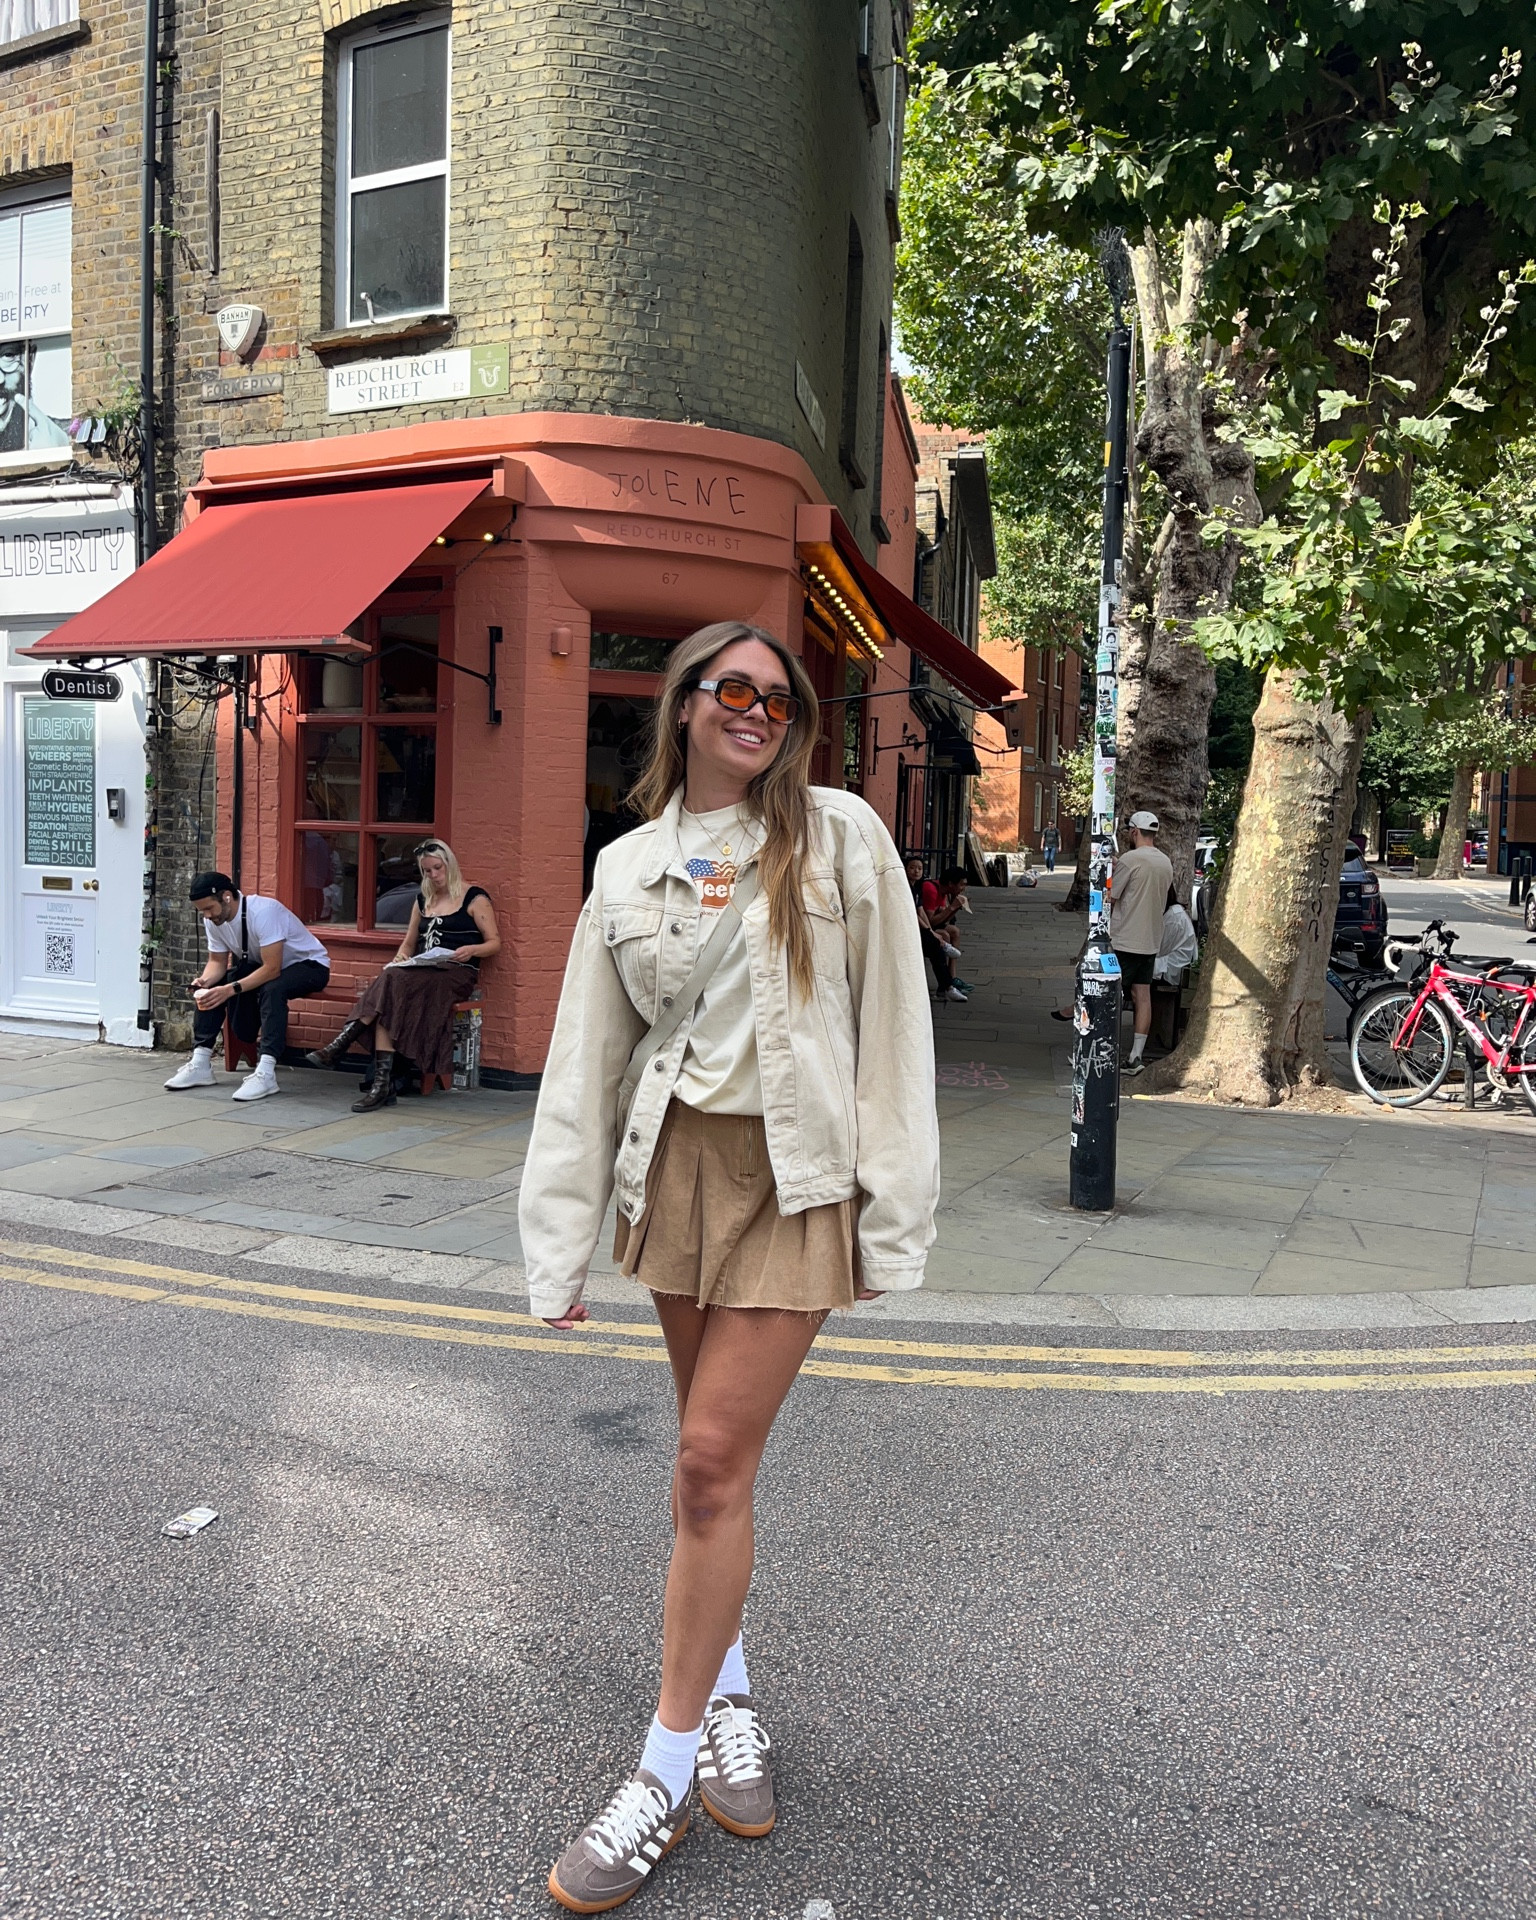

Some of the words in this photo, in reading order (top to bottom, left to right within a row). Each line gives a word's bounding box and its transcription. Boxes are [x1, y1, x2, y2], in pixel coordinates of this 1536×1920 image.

[51, 282, 61, 294] at
[221, 311, 249, 324] BANHAM
[335, 358, 447, 388] REDCHURCH
[357, 381, 422, 404] STREET
[453, 382, 464, 392] E2
[607, 522, 716, 547] REDCHURCH
[724, 537, 742, 551] ST
[0, 527, 124, 577] LIBERTY
[662, 572, 680, 585] 67
[55, 678, 111, 695] Dentist
[28, 717, 94, 740] LIBERTY
[28, 751, 72, 761] VENEERS
[28, 762, 61, 771] Cosmetic
[62, 763, 93, 773] Bonding
[28, 779, 93, 793] IMPLANTS
[28, 793, 51, 801] TEETH
[51, 793, 93, 802] WHITENING
[47, 802, 93, 814] HYGIENE
[28, 813, 60, 821] NERVOUS
[61, 814, 93, 822] PATIENTS
[28, 821, 68, 831] SEDATION
[28, 830, 51, 839] FACIAL
[52, 831, 93, 841] AESTHETICS
[51, 840, 93, 853] SMILE
[51, 852, 93, 866] DESIGN
